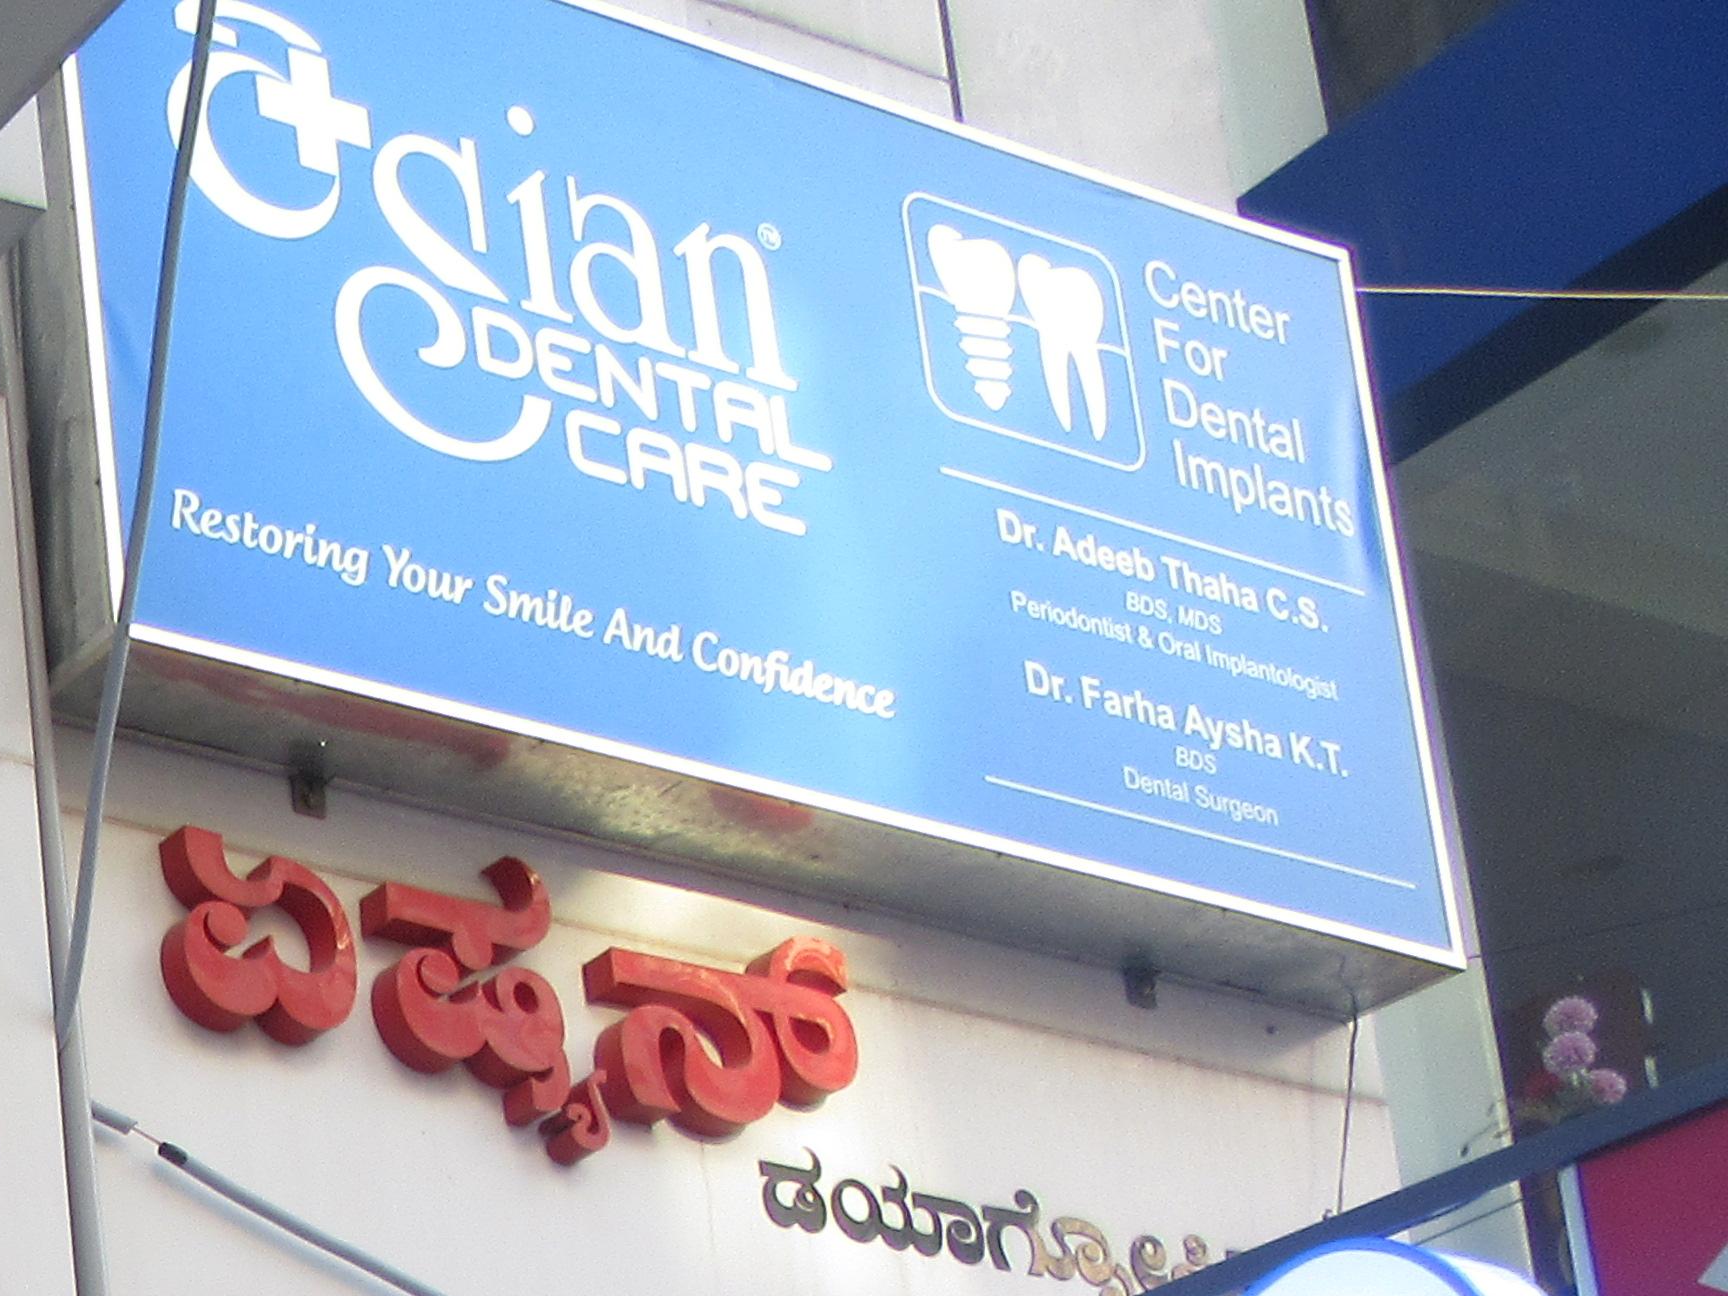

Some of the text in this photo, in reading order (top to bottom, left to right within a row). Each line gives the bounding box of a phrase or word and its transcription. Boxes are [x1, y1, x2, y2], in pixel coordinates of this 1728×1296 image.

[1144, 260, 1290, 345] Center
[1152, 319, 1228, 381] For
[473, 307, 832, 471] DENTAL
[1161, 378, 1307, 465] Dental
[564, 411, 806, 536] CARE
[1172, 438, 1355, 538] Implants
[171, 488, 897, 719] Restoring Your Smile And Confidence
[996, 509, 1330, 633] Dr. Adeeb Thaha C.S.
[1178, 604, 1222, 635] MDS
[1011, 590, 1339, 702] Periodontist & Oral Implantologist
[1024, 660, 1348, 777] Dr. Farha Aysha K.T.
[1175, 745, 1216, 776] BDS
[1123, 765, 1279, 827] Dental Surgeon
